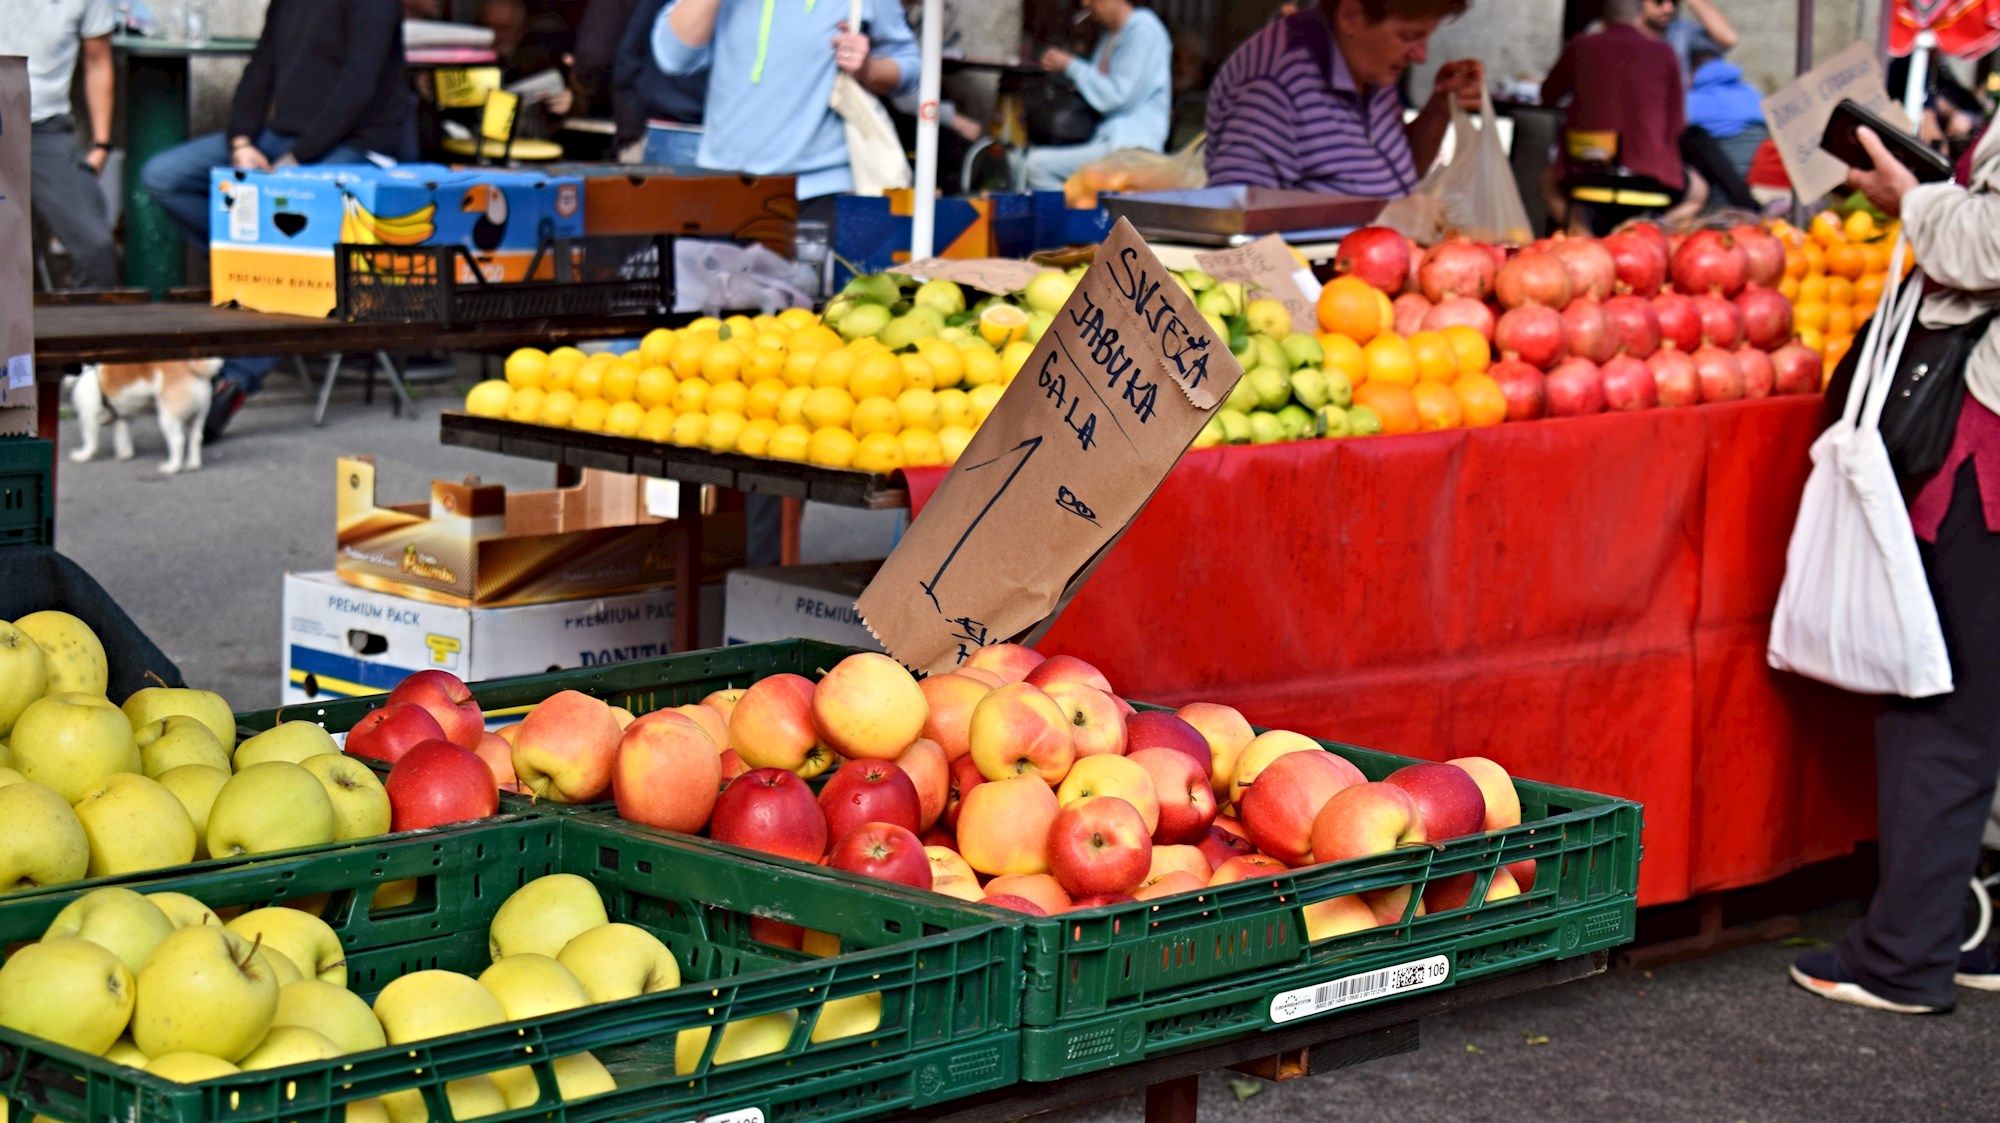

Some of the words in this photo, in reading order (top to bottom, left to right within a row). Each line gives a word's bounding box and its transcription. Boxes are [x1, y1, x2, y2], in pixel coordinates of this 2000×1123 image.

[228, 272, 284, 286] PREMIUM
[289, 277, 335, 290] BANAN
[1069, 292, 1158, 425] JABUKA
[1037, 350, 1097, 451] GALA
[328, 594, 383, 619] PREMIUM
[387, 607, 421, 627] PACK
[645, 602, 676, 621] PAC
[795, 596, 865, 626] PREMIUM
[1427, 962, 1446, 979] 106
